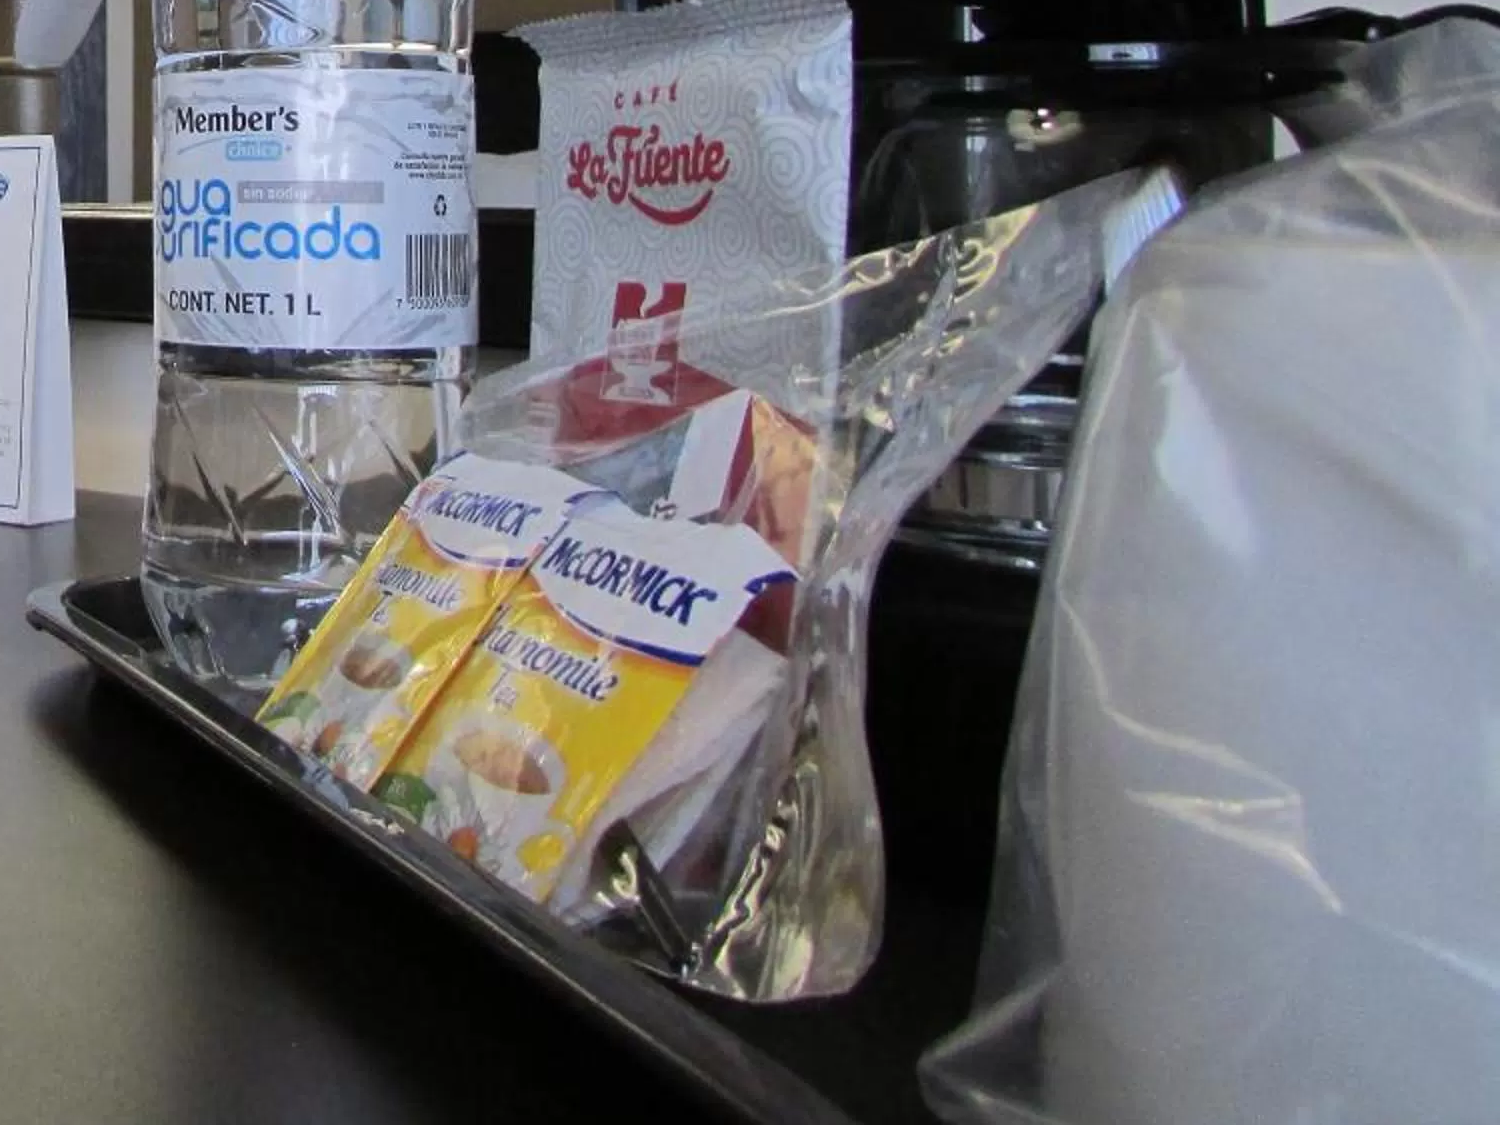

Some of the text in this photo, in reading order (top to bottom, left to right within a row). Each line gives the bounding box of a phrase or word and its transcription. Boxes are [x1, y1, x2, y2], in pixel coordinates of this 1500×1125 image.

[175, 105, 300, 135] Member's
[567, 141, 608, 200] La
[161, 178, 231, 233] gua
[161, 206, 381, 263] urificada
[169, 290, 321, 315] CONT. NET. 1 L
[542, 537, 718, 627] McCORMICK
[480, 603, 619, 702] hamomile
